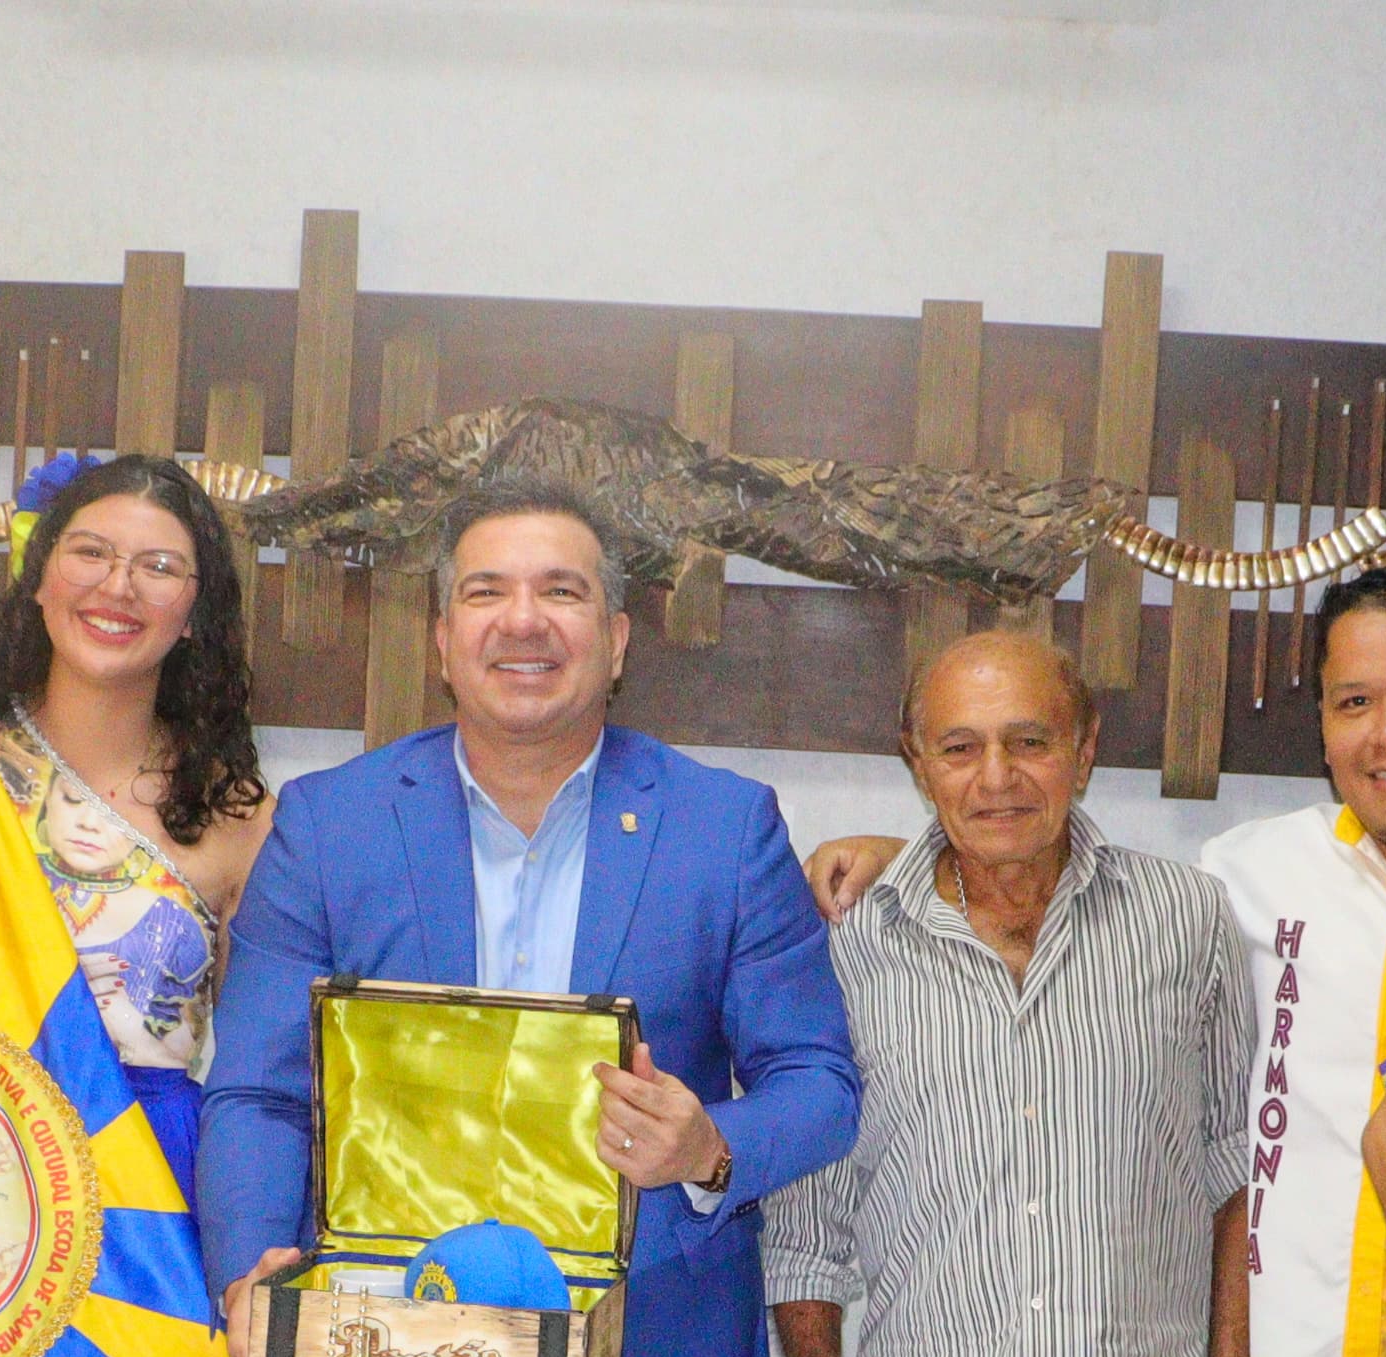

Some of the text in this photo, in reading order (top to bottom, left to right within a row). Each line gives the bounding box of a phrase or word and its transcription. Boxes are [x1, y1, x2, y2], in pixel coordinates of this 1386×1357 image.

[19, 1102, 38, 1120] E
[1248, 918, 1306, 1275] HARMONIA
[29, 1119, 72, 1205] CULTURAL
[46, 1209, 75, 1274] ESCOLA
[34, 1277, 58, 1306] DE
